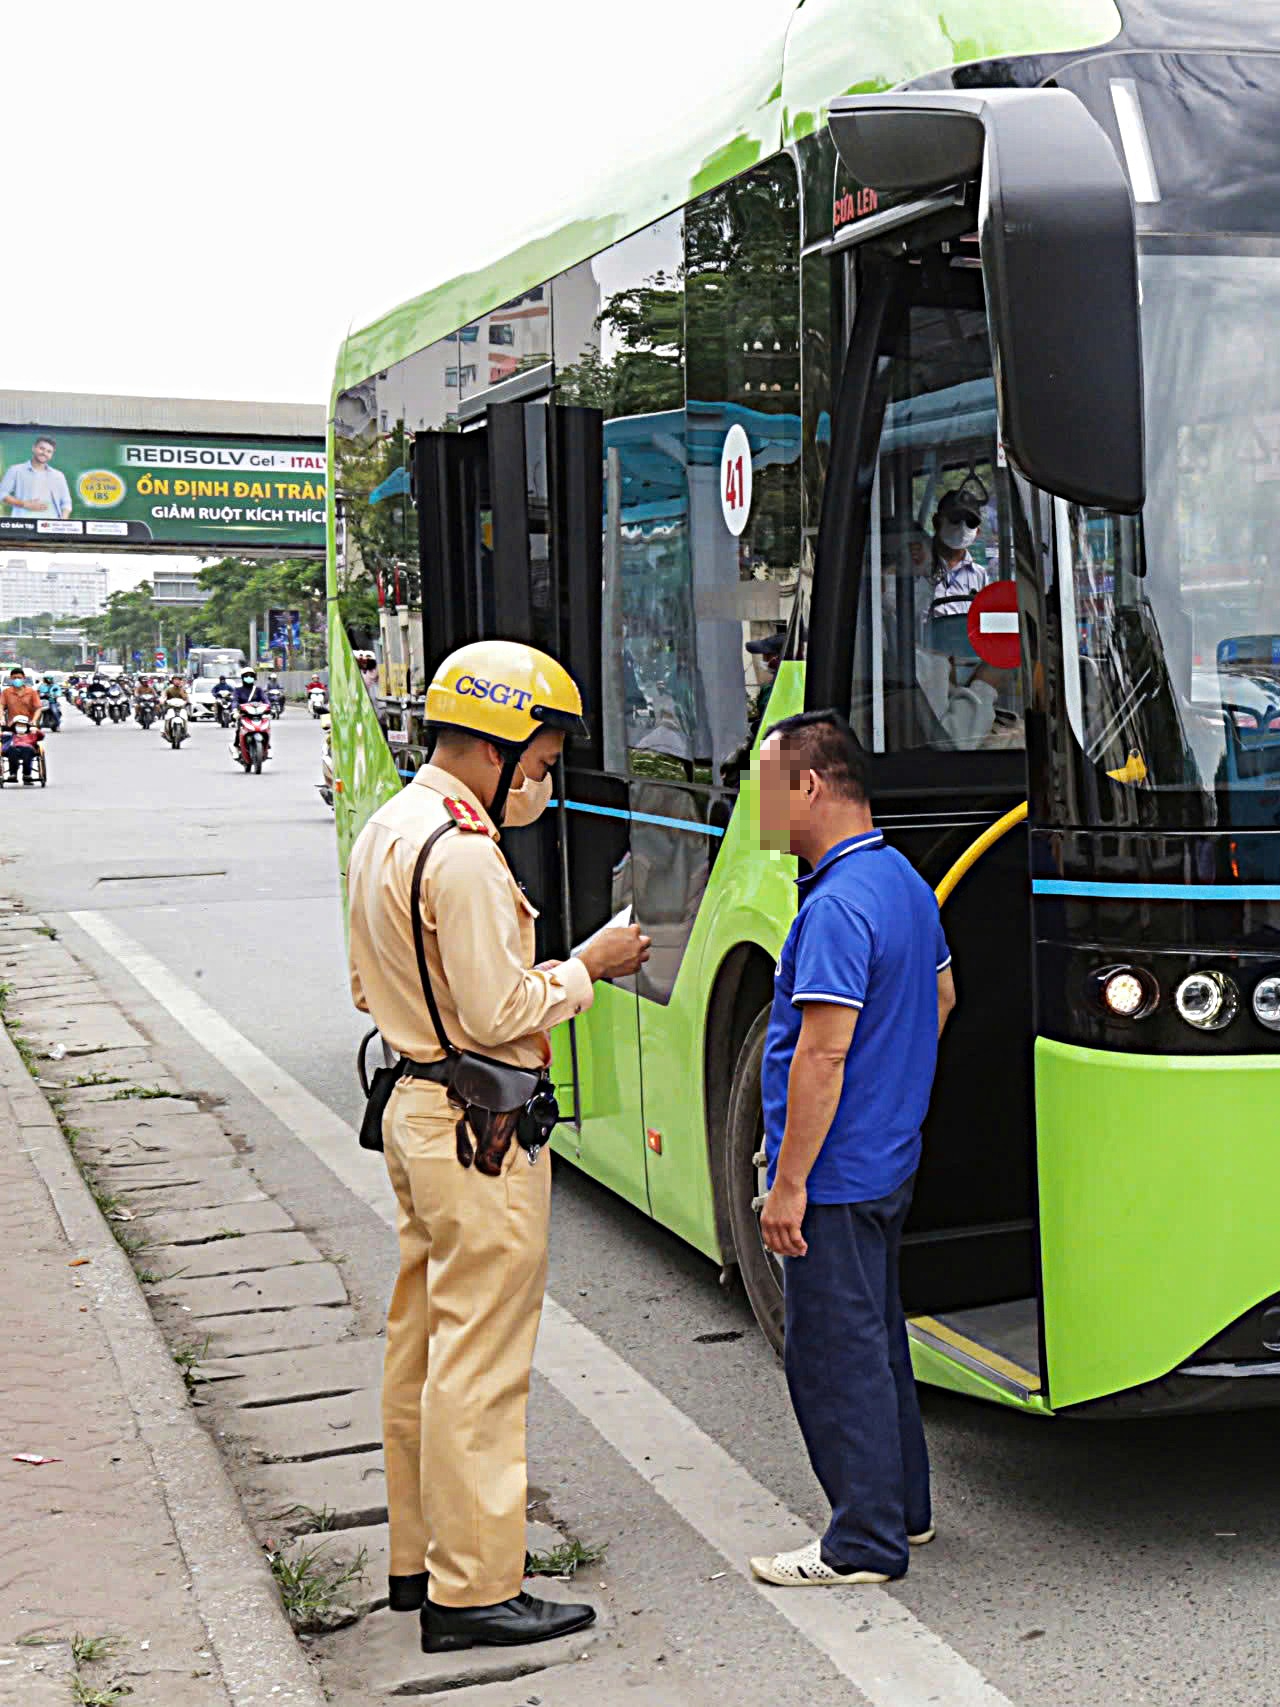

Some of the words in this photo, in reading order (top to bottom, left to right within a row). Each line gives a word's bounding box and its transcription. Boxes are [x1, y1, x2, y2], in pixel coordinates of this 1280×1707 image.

[127, 448, 245, 466] REDISOLV
[250, 455, 275, 467] Gel
[136, 473, 170, 496] ỔN
[174, 480, 229, 500] ĐỊNH
[233, 482, 271, 503] ĐẠI
[725, 455, 744, 511] 41
[151, 503, 195, 520] GIẢM
[199, 504, 242, 523] RUỘT
[246, 506, 282, 522] KÍCH
[455, 675, 532, 711] CSGT
